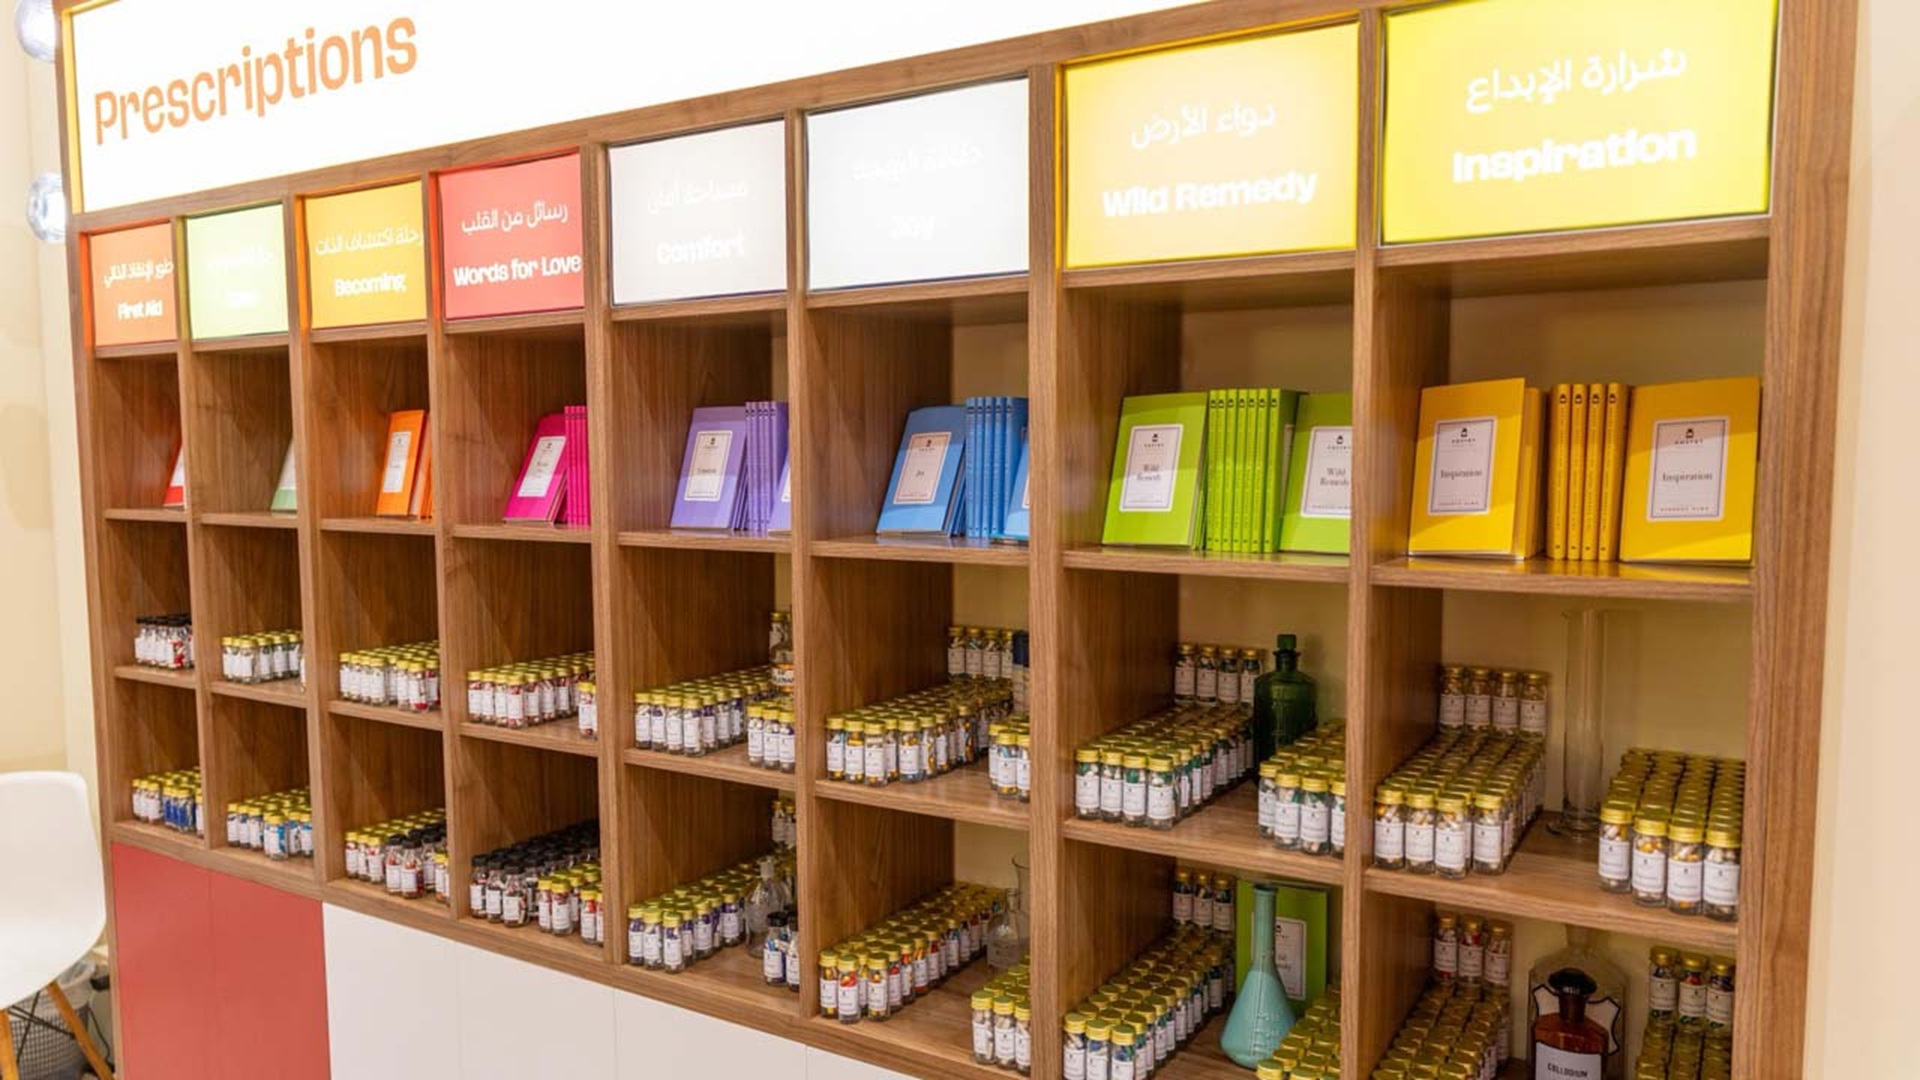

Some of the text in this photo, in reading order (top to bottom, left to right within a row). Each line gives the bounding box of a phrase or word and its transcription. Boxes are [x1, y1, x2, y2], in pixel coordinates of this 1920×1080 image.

[95, 17, 419, 145] Prescriptions
[1465, 46, 1690, 114] شرارة الإبداع
[1450, 128, 1698, 184] Inspiration
[1101, 168, 1319, 217] Wild Remedy
[461, 199, 569, 237] رسائل من القلب
[656, 229, 746, 264] Comfort
[334, 271, 407, 297] Becoming
[453, 254, 583, 287] Words for Love
[1662, 471, 1713, 485] Inspiration
